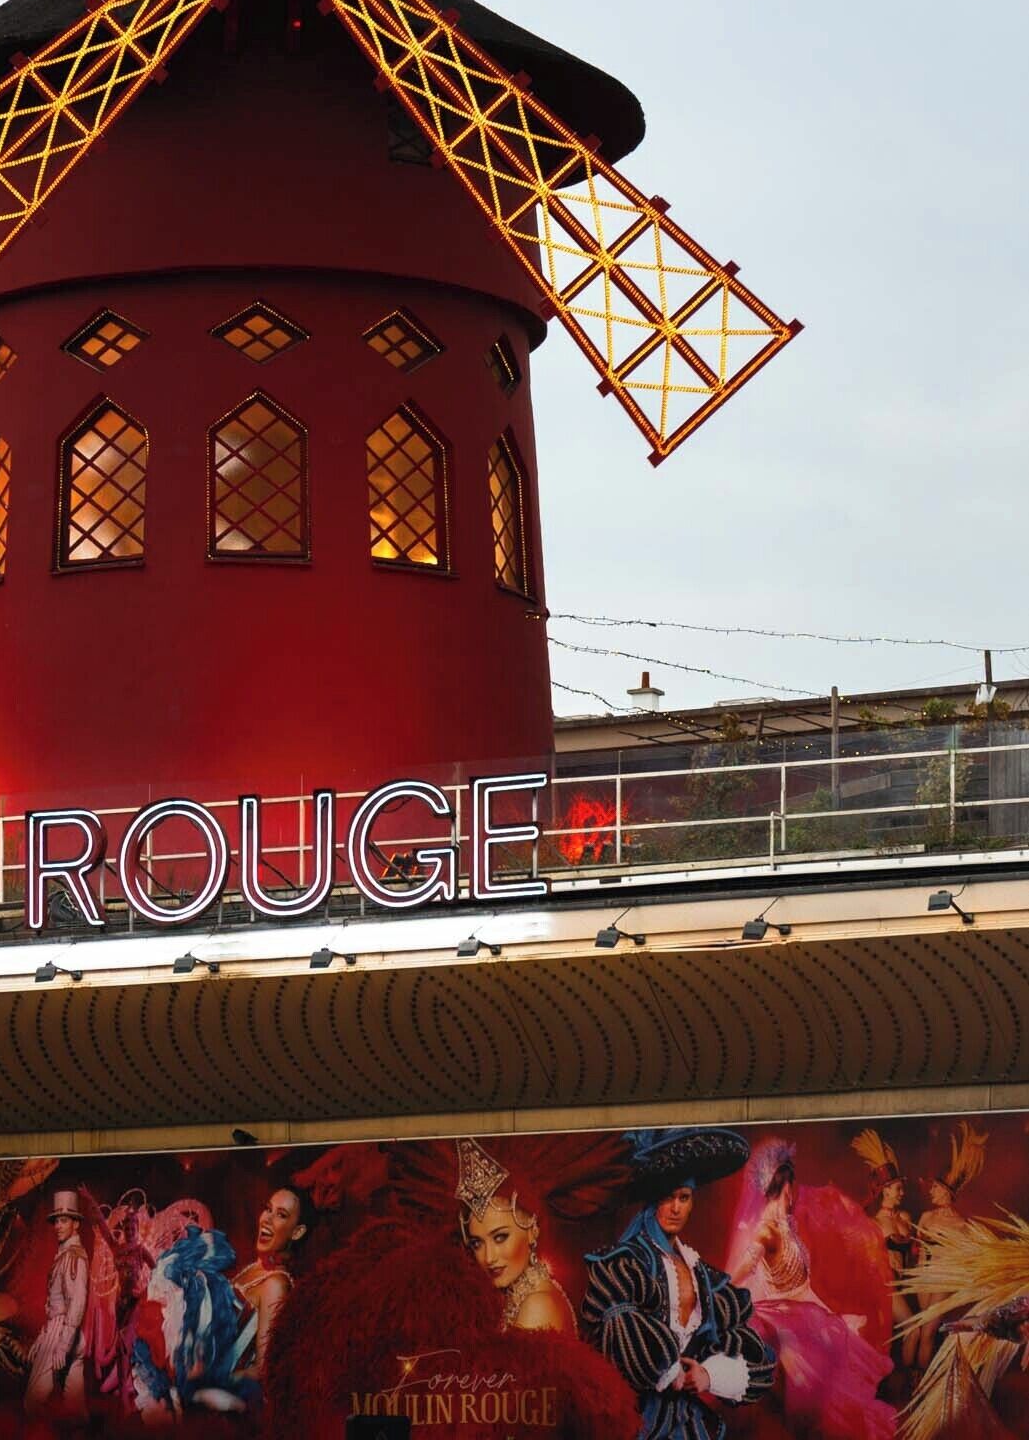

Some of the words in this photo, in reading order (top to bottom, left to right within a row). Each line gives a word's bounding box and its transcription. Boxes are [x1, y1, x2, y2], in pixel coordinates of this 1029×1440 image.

[25, 772, 552, 929] ROUGE
[381, 1348, 518, 1398] Forever
[350, 1391, 453, 1426] MOULIN
[459, 1387, 557, 1426] ROUGE
